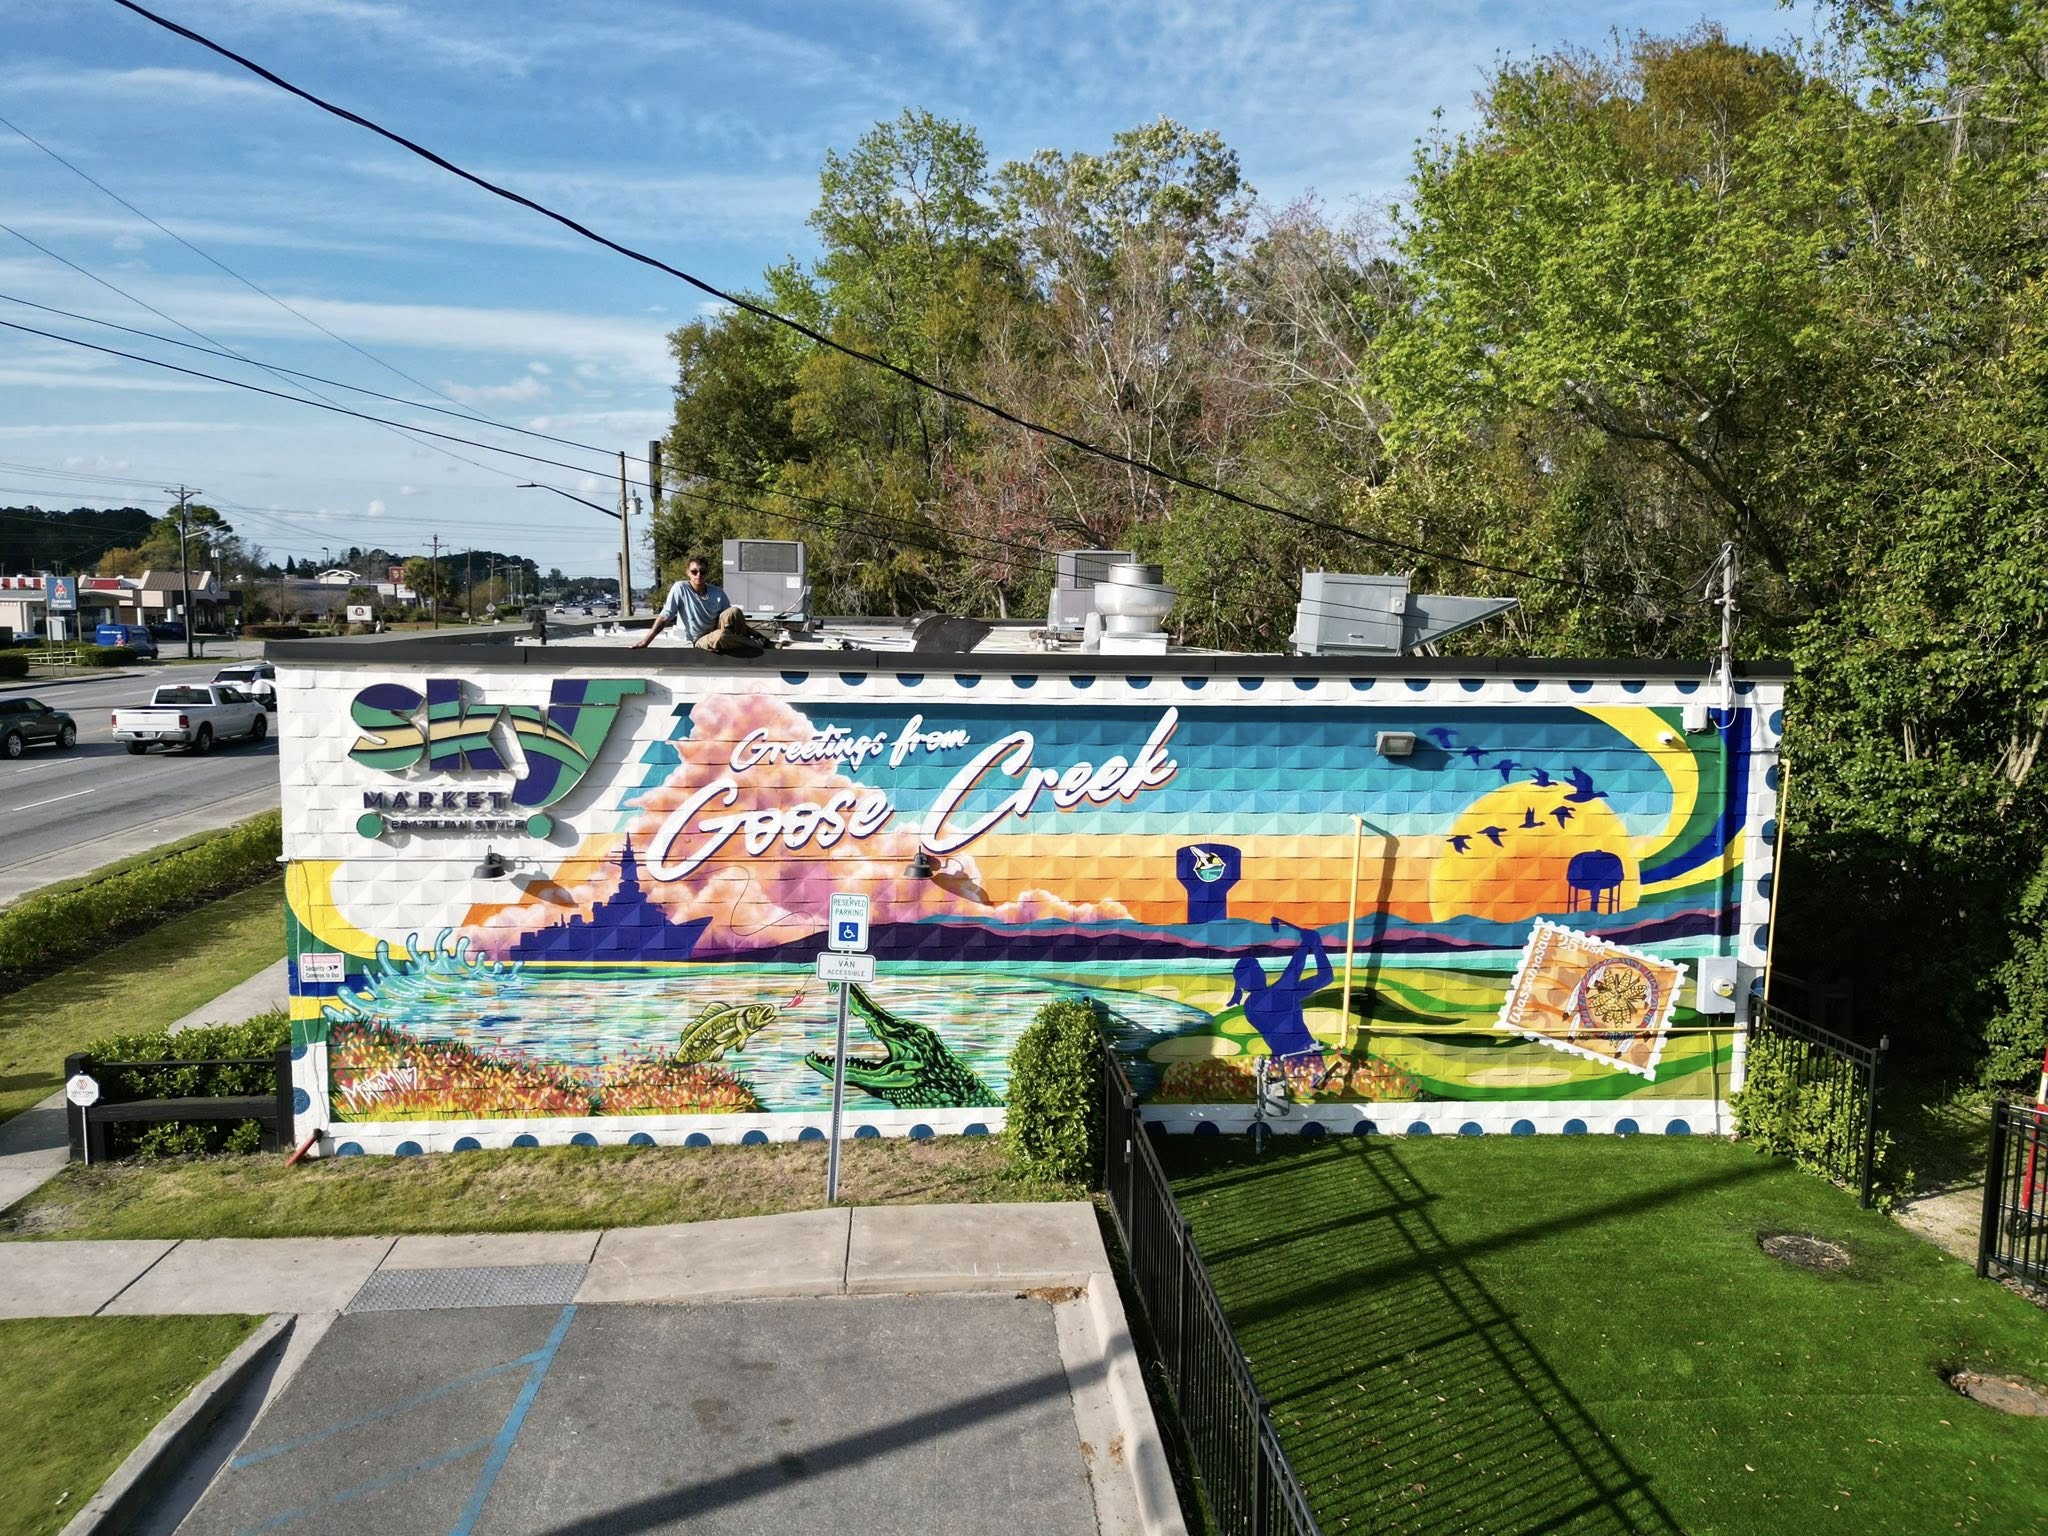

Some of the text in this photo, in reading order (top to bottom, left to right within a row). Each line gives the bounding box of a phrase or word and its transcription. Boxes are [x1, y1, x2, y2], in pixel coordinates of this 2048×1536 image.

[729, 714, 969, 774] Greetings from
[646, 706, 1180, 883] Goose Creek
[363, 791, 504, 809] MARKET
[391, 820, 527, 830] BRAZILIAN STYLE
[833, 898, 867, 907] RESERVED
[835, 908, 864, 917] PARKING
[838, 960, 856, 968] VAN
[827, 969, 865, 977] ACCESSIBLE
